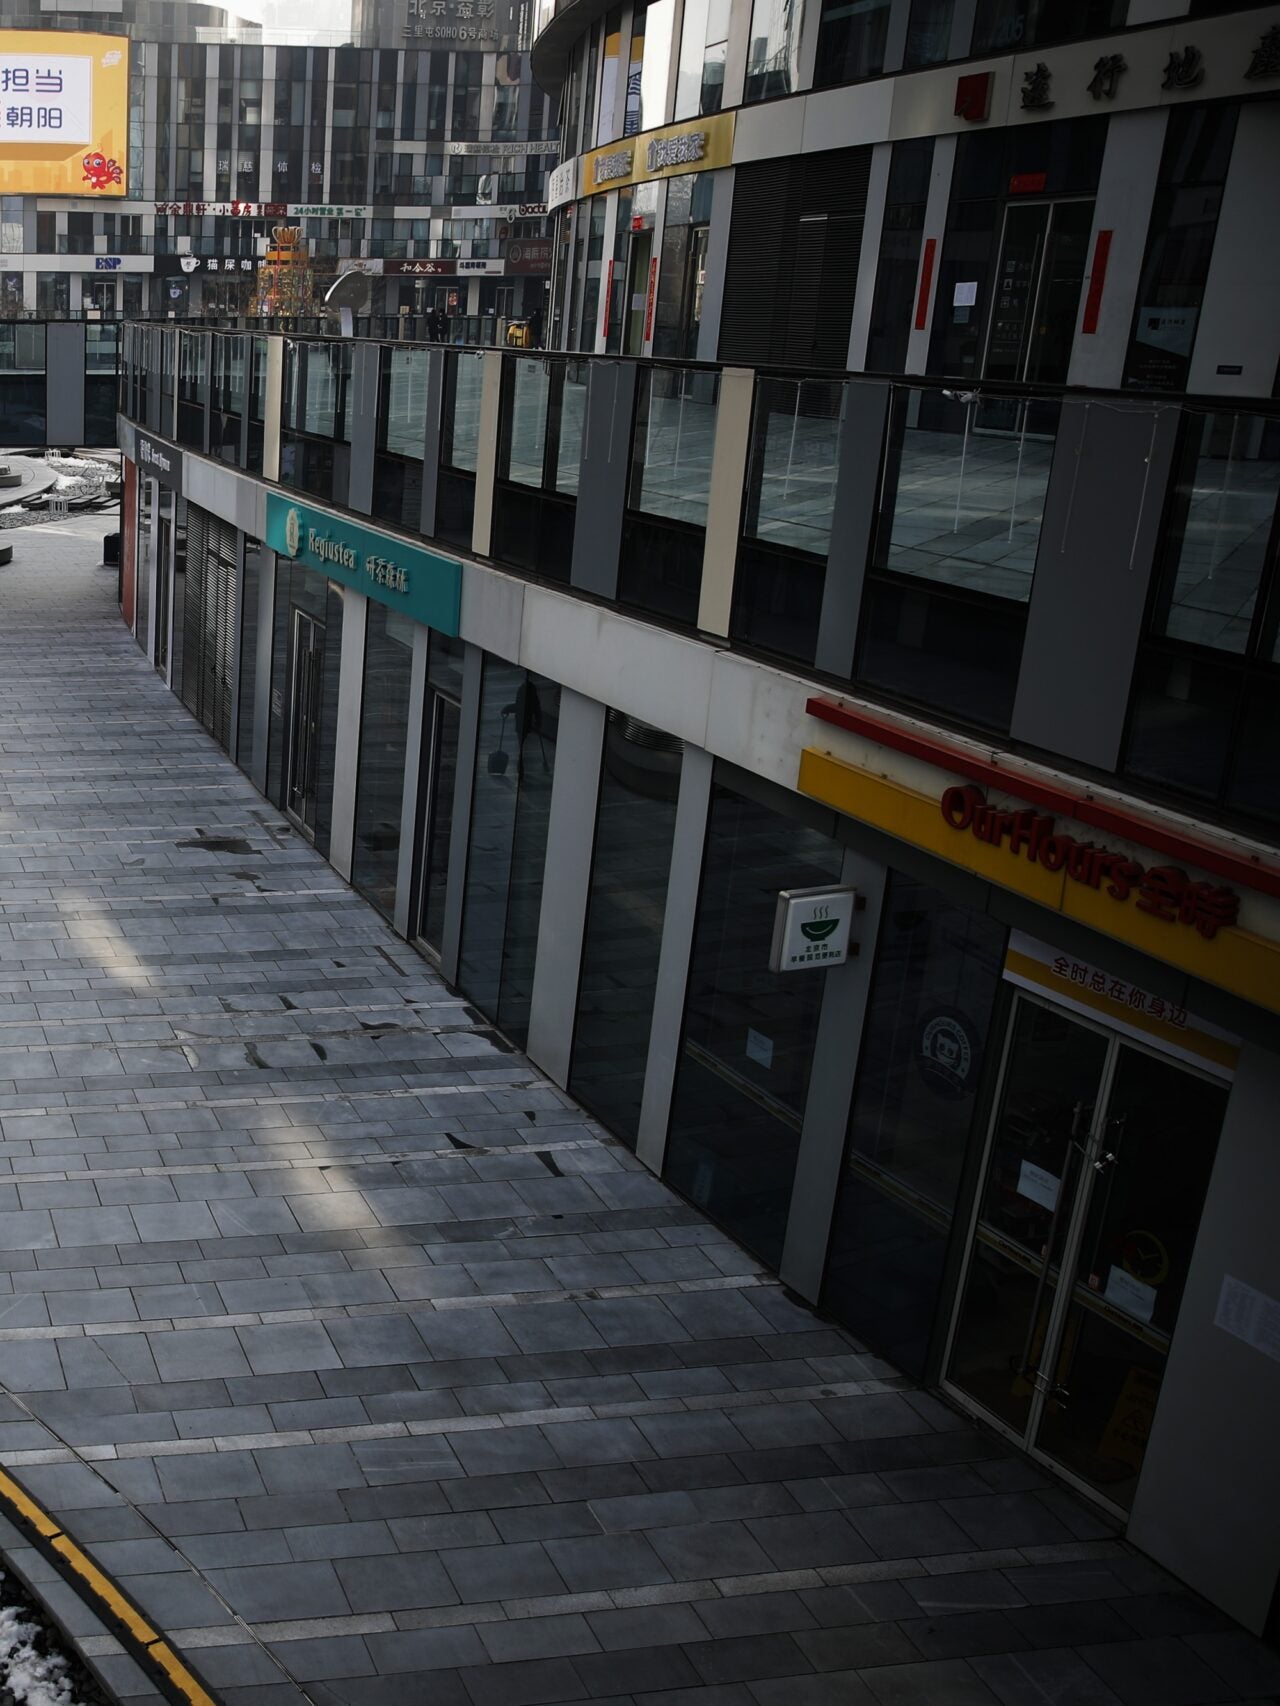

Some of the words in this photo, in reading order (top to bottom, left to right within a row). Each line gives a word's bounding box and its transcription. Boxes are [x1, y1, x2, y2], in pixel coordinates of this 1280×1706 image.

[1051, 956, 1188, 1029] 全时总在你身边
